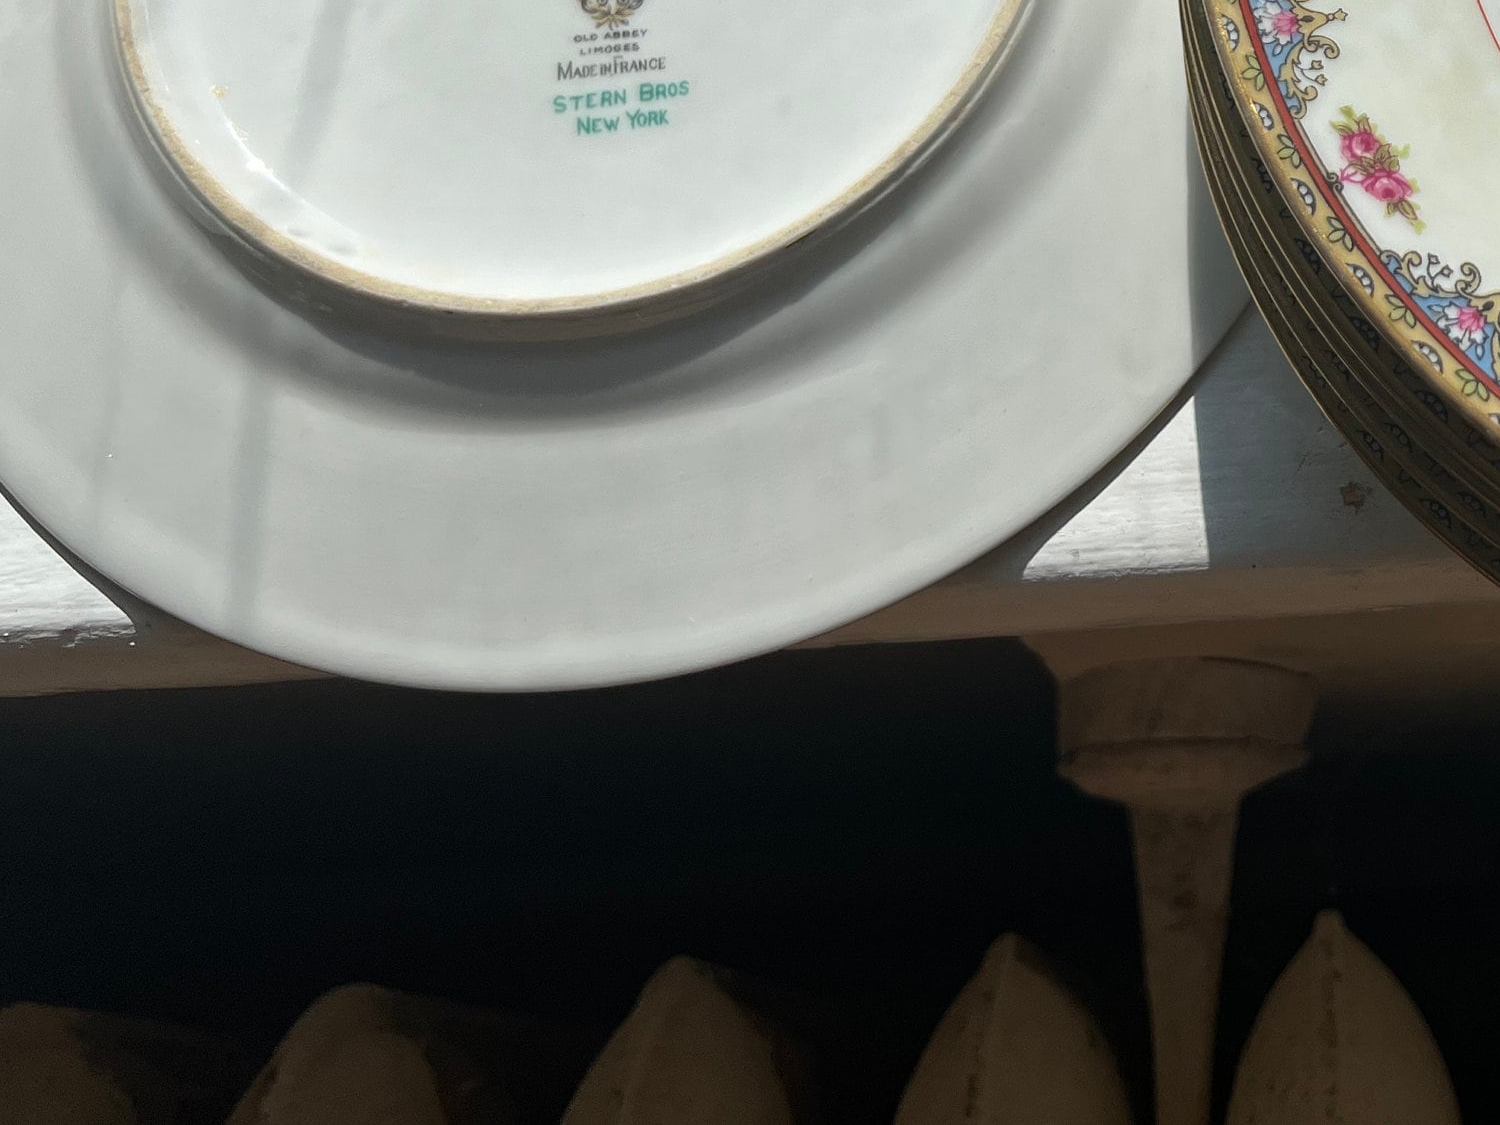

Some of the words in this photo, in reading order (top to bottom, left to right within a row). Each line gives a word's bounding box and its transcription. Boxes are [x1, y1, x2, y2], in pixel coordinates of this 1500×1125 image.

[573, 33, 598, 43] OLD
[603, 29, 648, 40] ABBEY
[580, 42, 640, 56] LIMOGES
[553, 89, 627, 114] STERN
[639, 80, 690, 102] BROS
[576, 115, 620, 136] NEW
[625, 109, 670, 130] YORK
